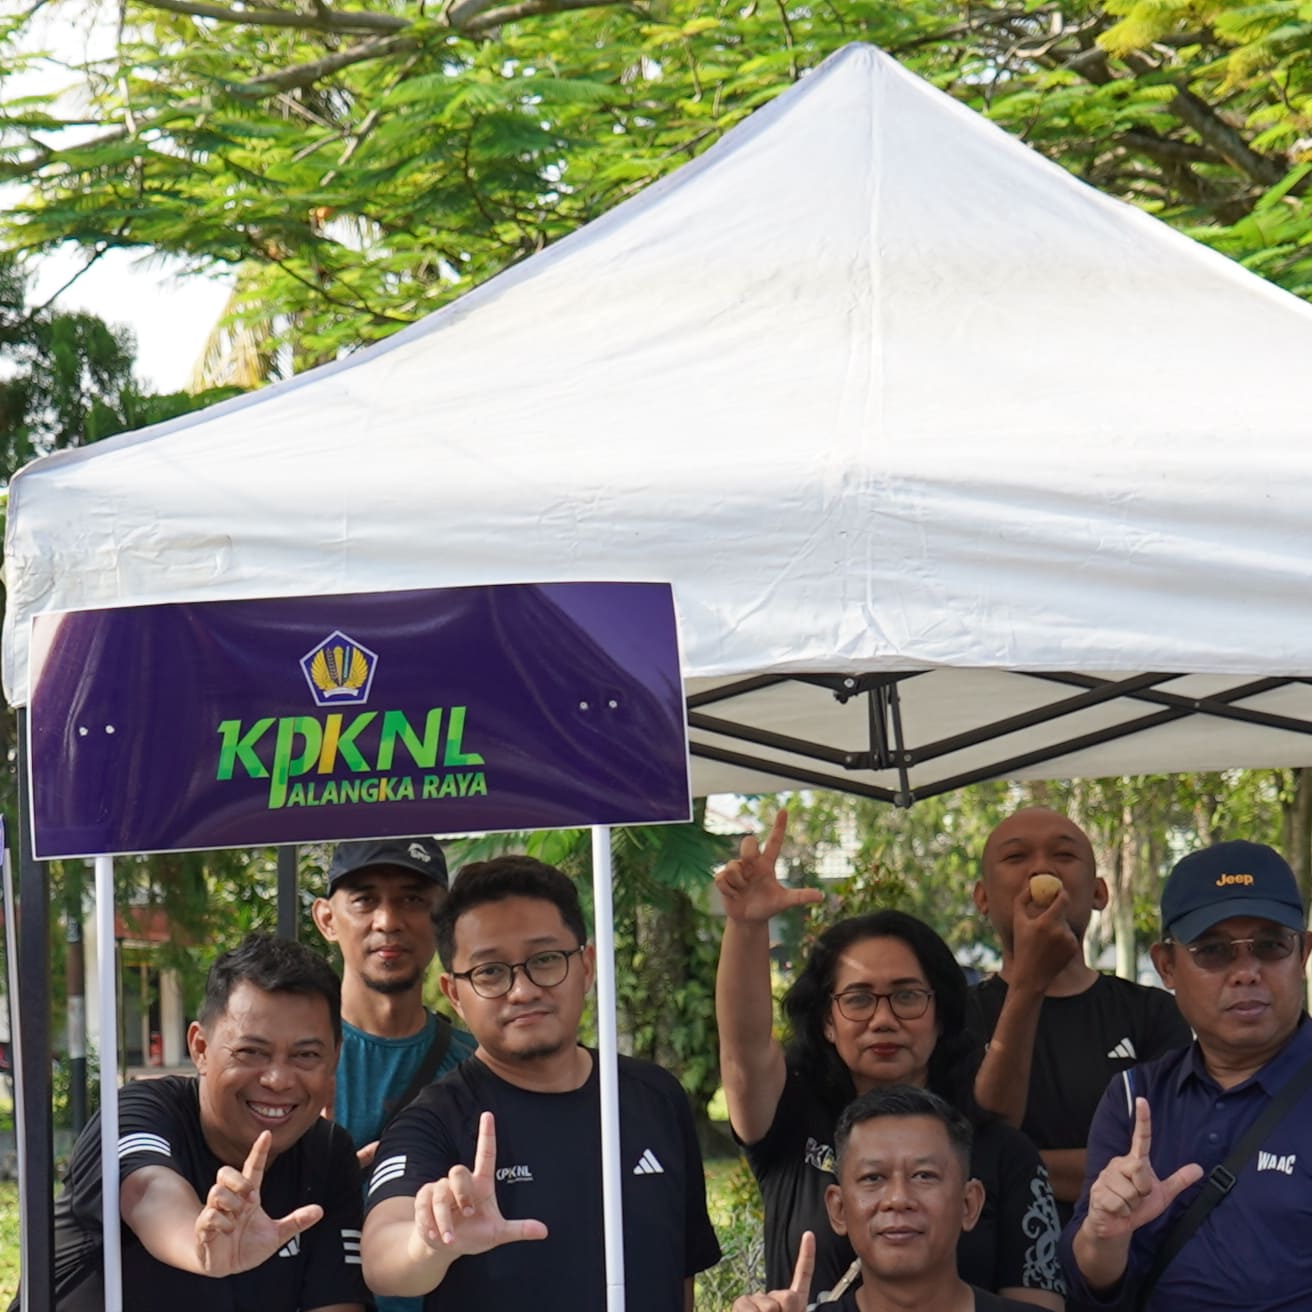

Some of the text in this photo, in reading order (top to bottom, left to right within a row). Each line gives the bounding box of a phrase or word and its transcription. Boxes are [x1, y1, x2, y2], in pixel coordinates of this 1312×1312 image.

[216, 706, 486, 809] KPKNL
[422, 772, 488, 800] RAYA
[1216, 873, 1254, 887] Jeep
[1257, 1150, 1297, 1175] WAAC
